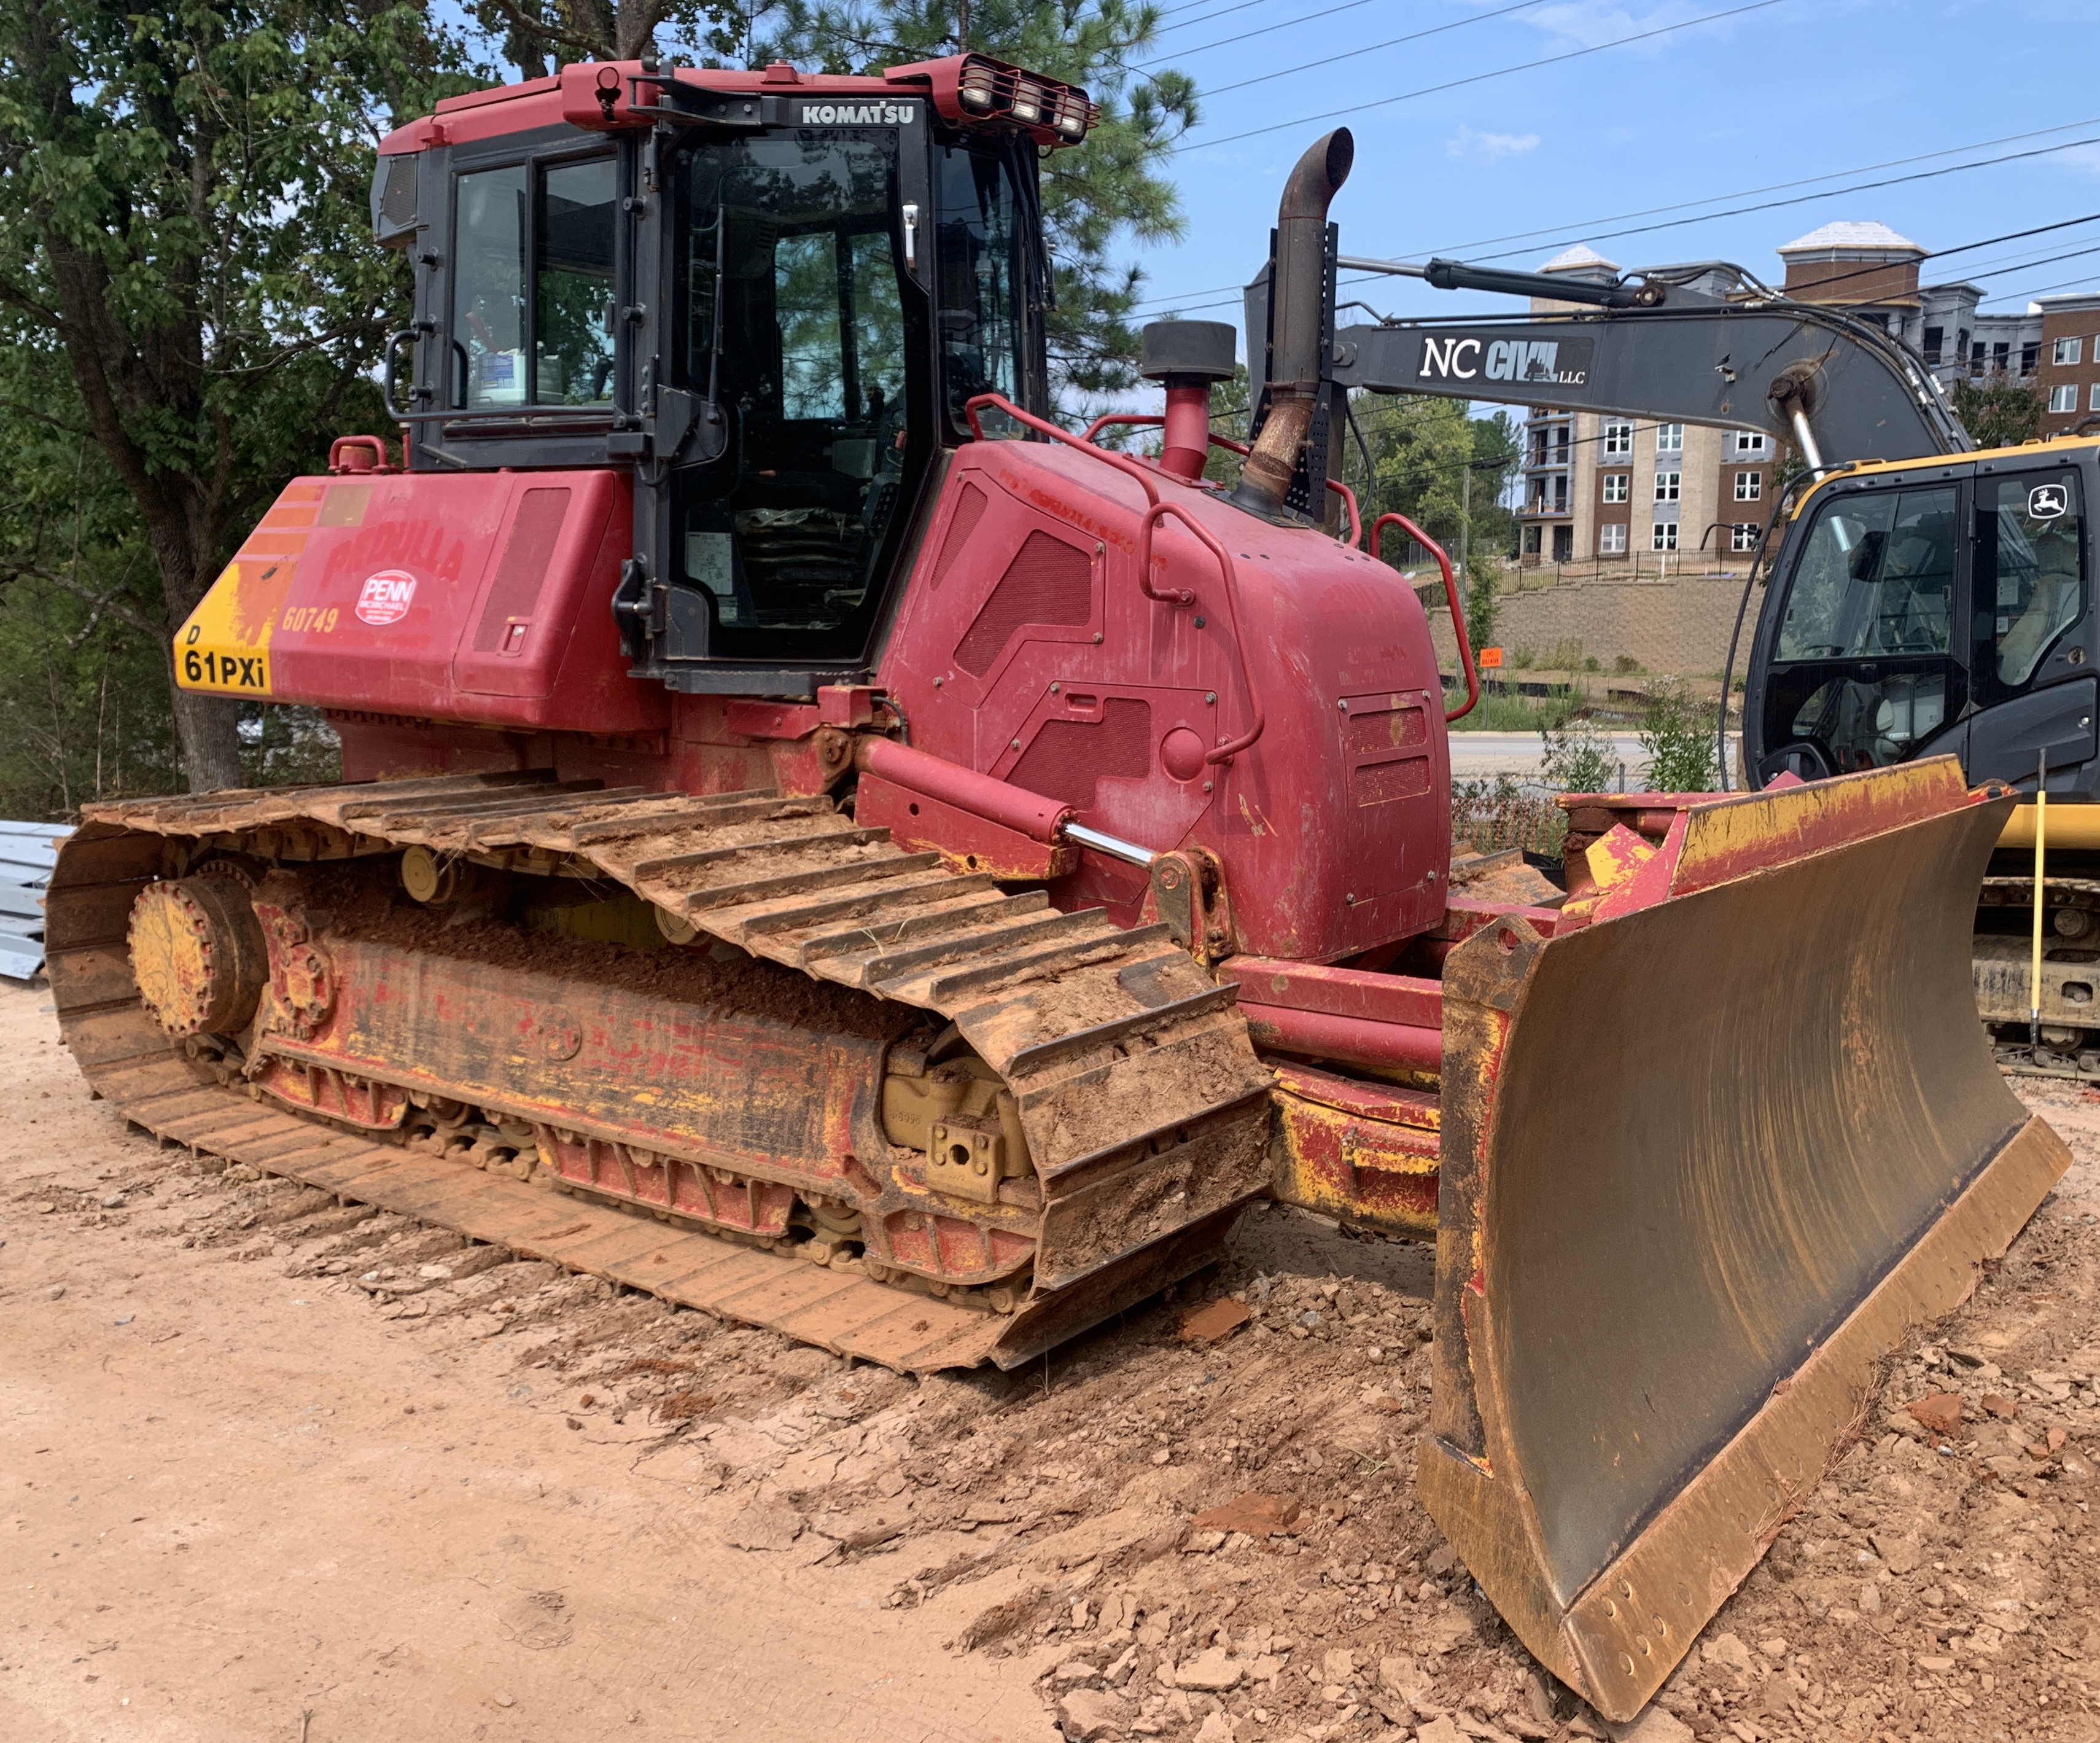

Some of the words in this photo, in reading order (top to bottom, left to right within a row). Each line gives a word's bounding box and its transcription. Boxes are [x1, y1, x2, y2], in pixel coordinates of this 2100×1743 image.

[802, 101, 914, 123] KOMATSU
[1419, 337, 1481, 379] NC
[1485, 340, 1559, 383] CIVIL
[1558, 370, 1585, 384] LLC
[363, 579, 413, 602] PENN
[282, 607, 340, 633] 60749
[185, 625, 201, 645] D
[185, 650, 265, 688] 61PXi
